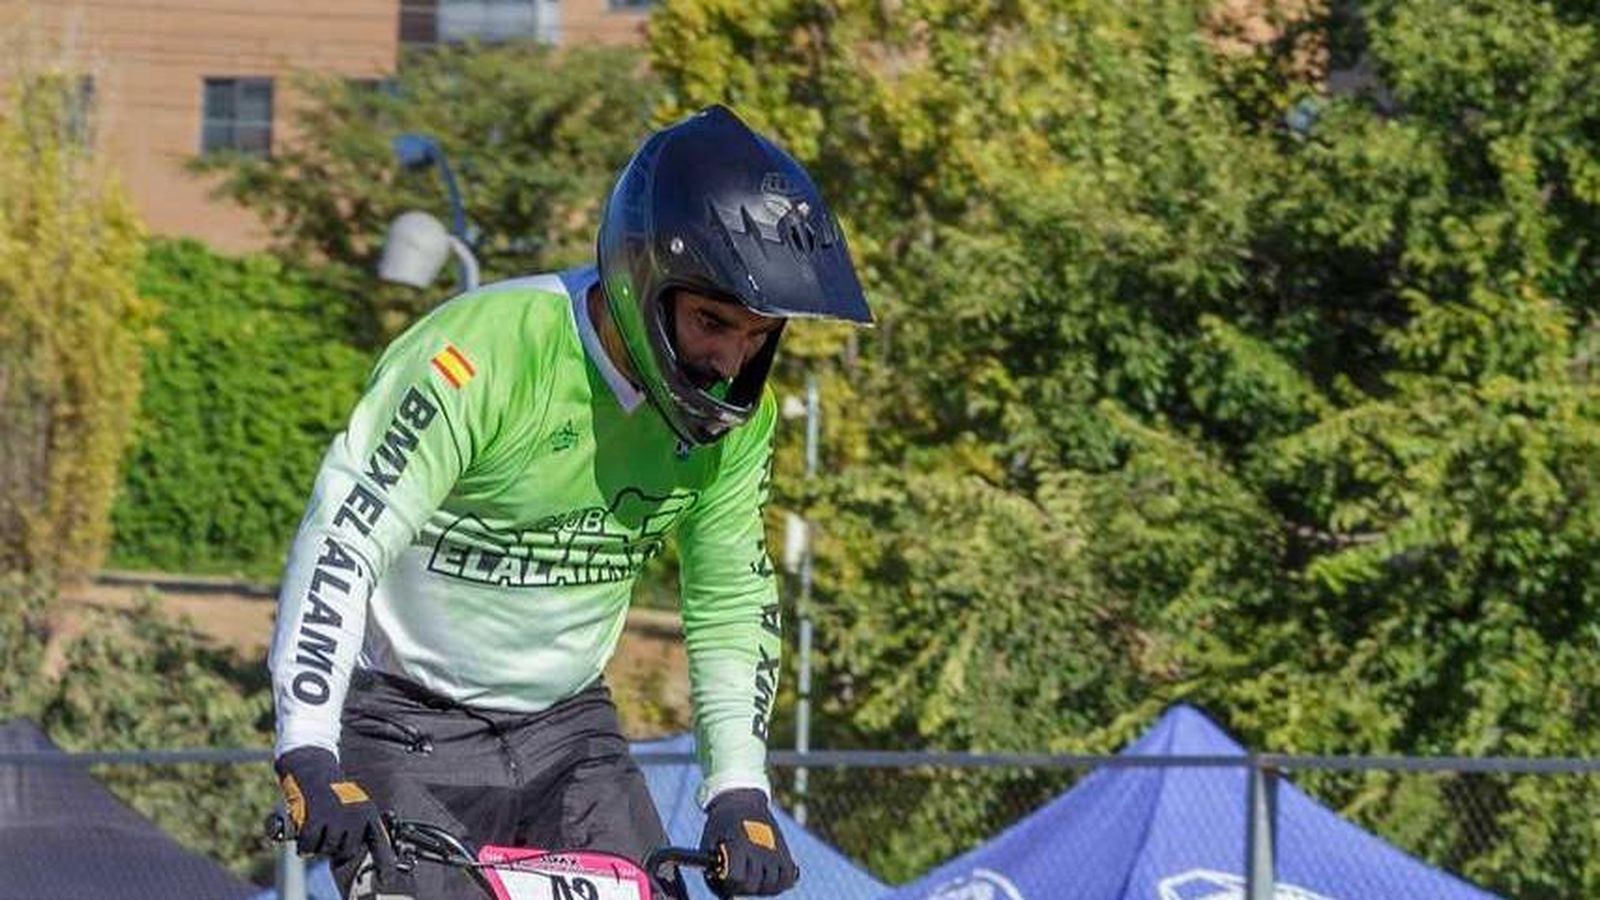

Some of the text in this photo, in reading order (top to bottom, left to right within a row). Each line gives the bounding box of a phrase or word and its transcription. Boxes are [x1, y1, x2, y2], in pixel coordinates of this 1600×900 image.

[291, 386, 438, 706] BMX EL ÁLAMO
